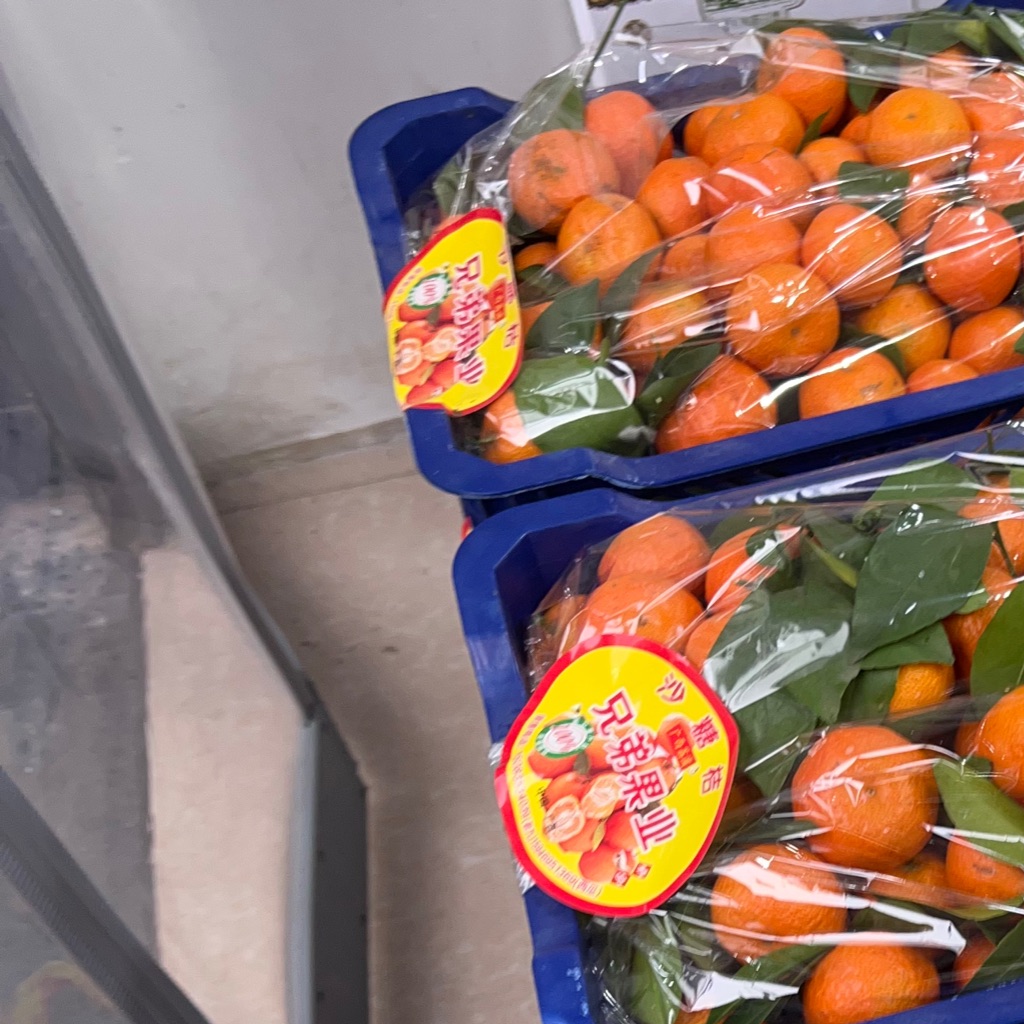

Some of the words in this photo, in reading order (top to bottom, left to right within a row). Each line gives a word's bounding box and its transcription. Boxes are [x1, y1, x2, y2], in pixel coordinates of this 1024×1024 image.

[590, 685, 681, 855] 兄弟果业
[655, 673, 723, 796] 沙糖桔
